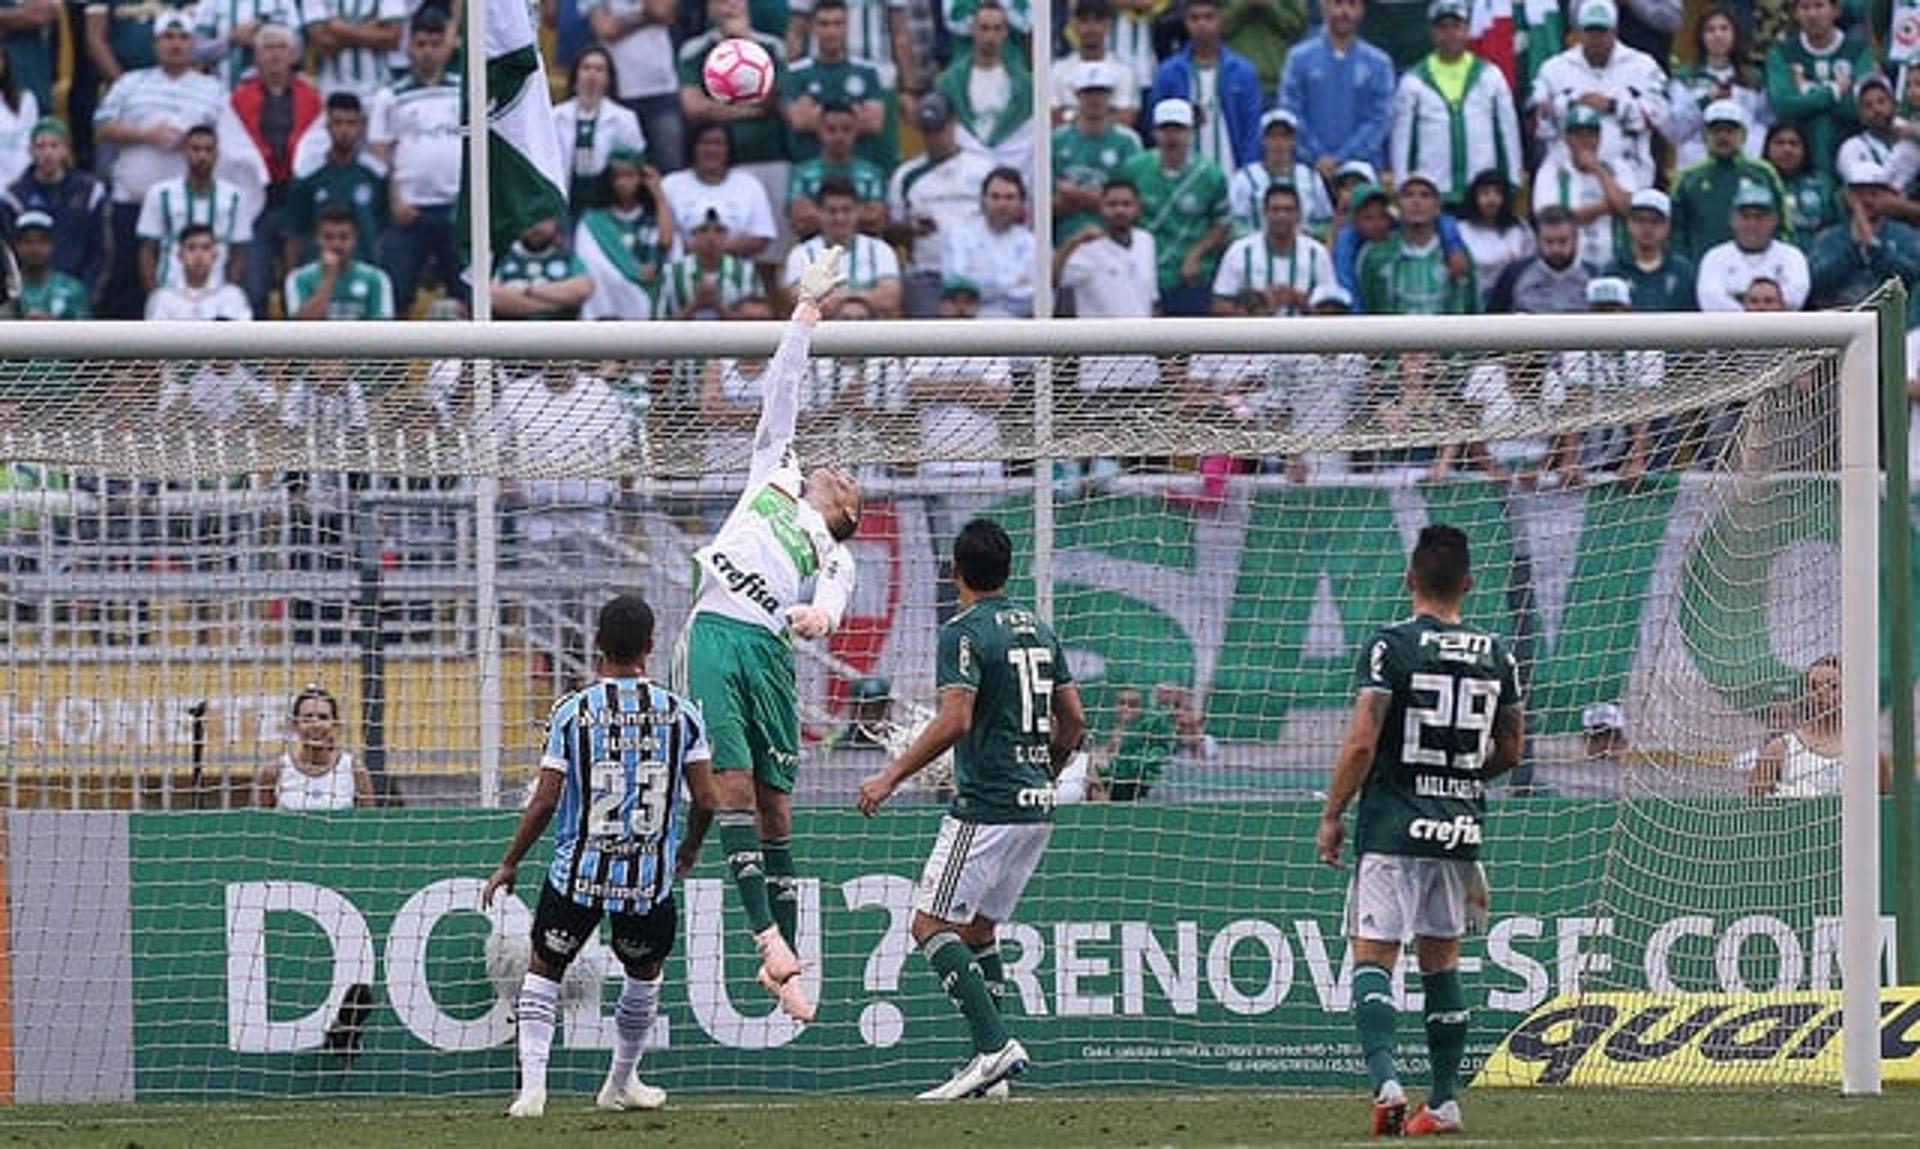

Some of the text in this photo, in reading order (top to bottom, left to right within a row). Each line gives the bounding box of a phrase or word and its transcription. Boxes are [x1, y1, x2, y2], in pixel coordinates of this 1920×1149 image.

[711, 552, 780, 615] crefisa
[1008, 648, 1054, 733] 15
[1401, 673, 1501, 769] 29
[588, 761, 668, 835] 23
[995, 915, 1898, 1017] RENOVE-SECOM
